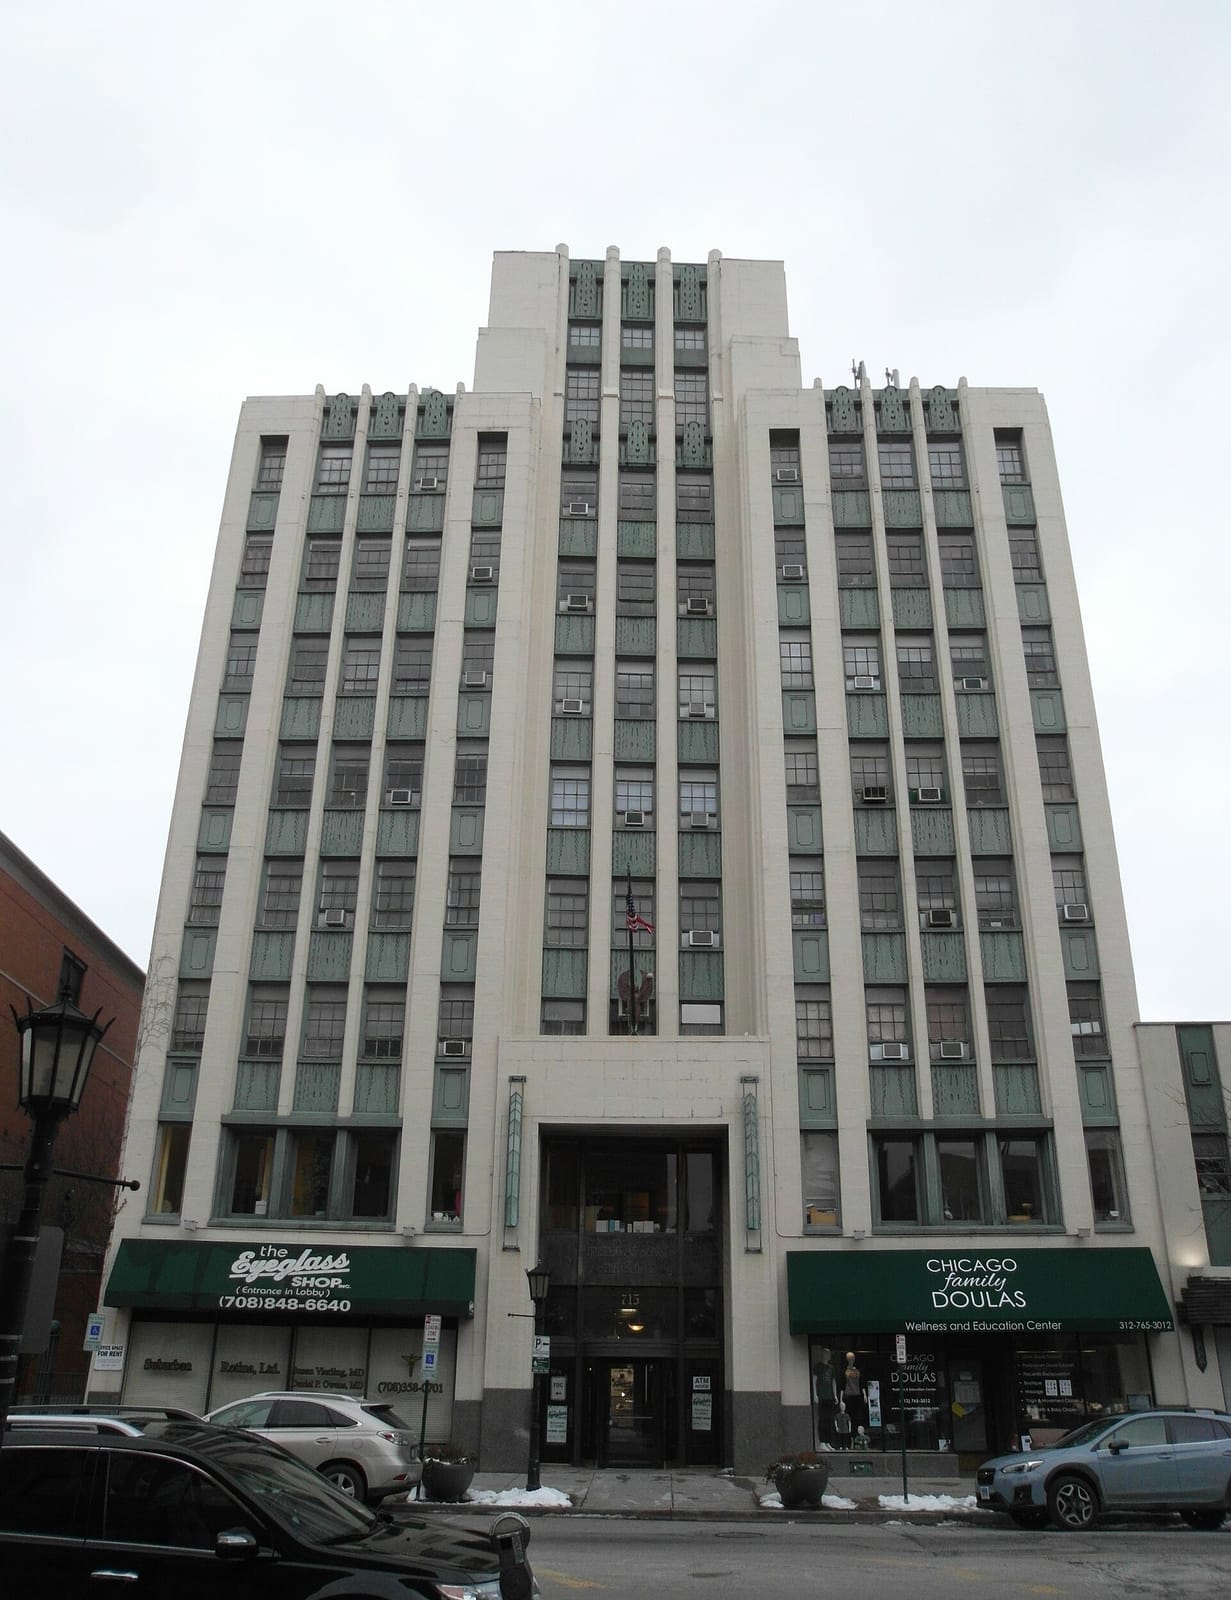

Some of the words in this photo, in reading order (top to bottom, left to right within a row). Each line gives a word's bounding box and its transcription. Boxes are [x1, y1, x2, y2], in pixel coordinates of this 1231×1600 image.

[260, 1245, 288, 1257] the
[231, 1249, 350, 1283] Eyeglass
[926, 1258, 1017, 1273] CHICAGO
[291, 1277, 342, 1288] SHOP
[940, 1272, 1007, 1292] family
[284, 1287, 293, 1295] in
[219, 1296, 351, 1312] (708)848-6640
[621, 1293, 640, 1305] 715
[931, 1290, 1026, 1308] DOULAS
[905, 1321, 947, 1331] Wellness
[949, 1321, 971, 1331] and
[972, 1321, 1024, 1331] Education
[1026, 1320, 1062, 1330] Center
[1119, 1321, 1172, 1330] 312-765-3012
[890, 1354, 935, 1362] CCAGO
